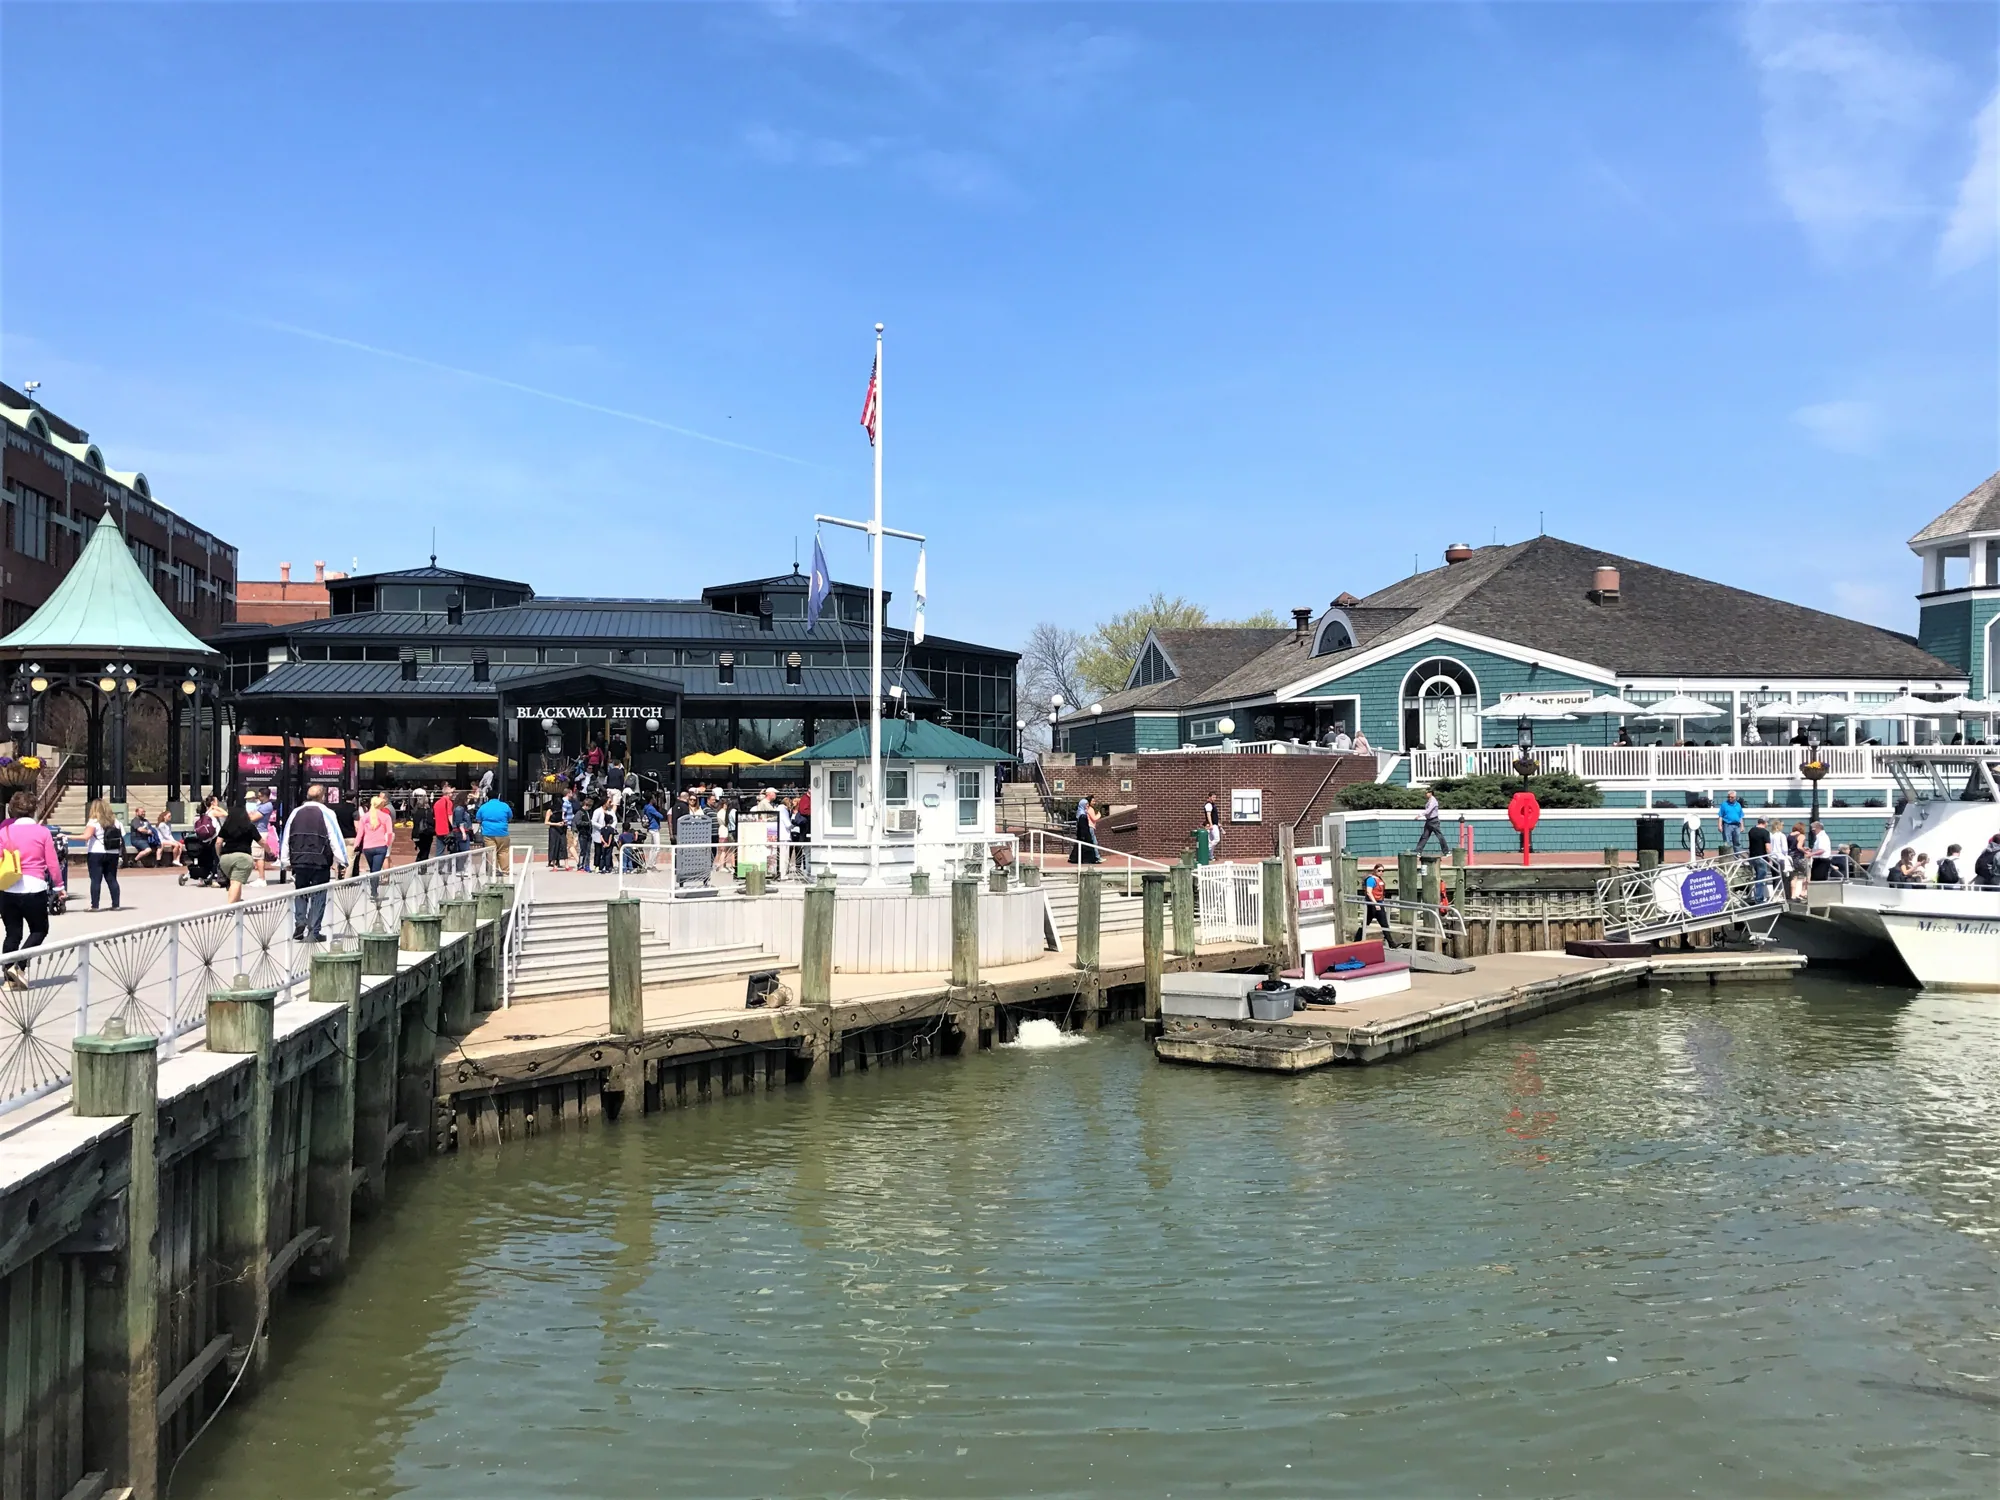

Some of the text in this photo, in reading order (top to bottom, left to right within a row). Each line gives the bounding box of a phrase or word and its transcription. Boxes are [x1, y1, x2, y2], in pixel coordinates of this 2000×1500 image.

[517, 706, 663, 719] BLACKWALL HITCH
[254, 767, 278, 776] history
[318, 768, 340, 776] charm
[1299, 867, 1322, 877] COMMERCIAL
[1690, 875, 1713, 884] Potomac
[1690, 881, 1716, 890] Riverboat
[1691, 887, 1717, 896] Company
[1916, 920, 1949, 933] Miss
